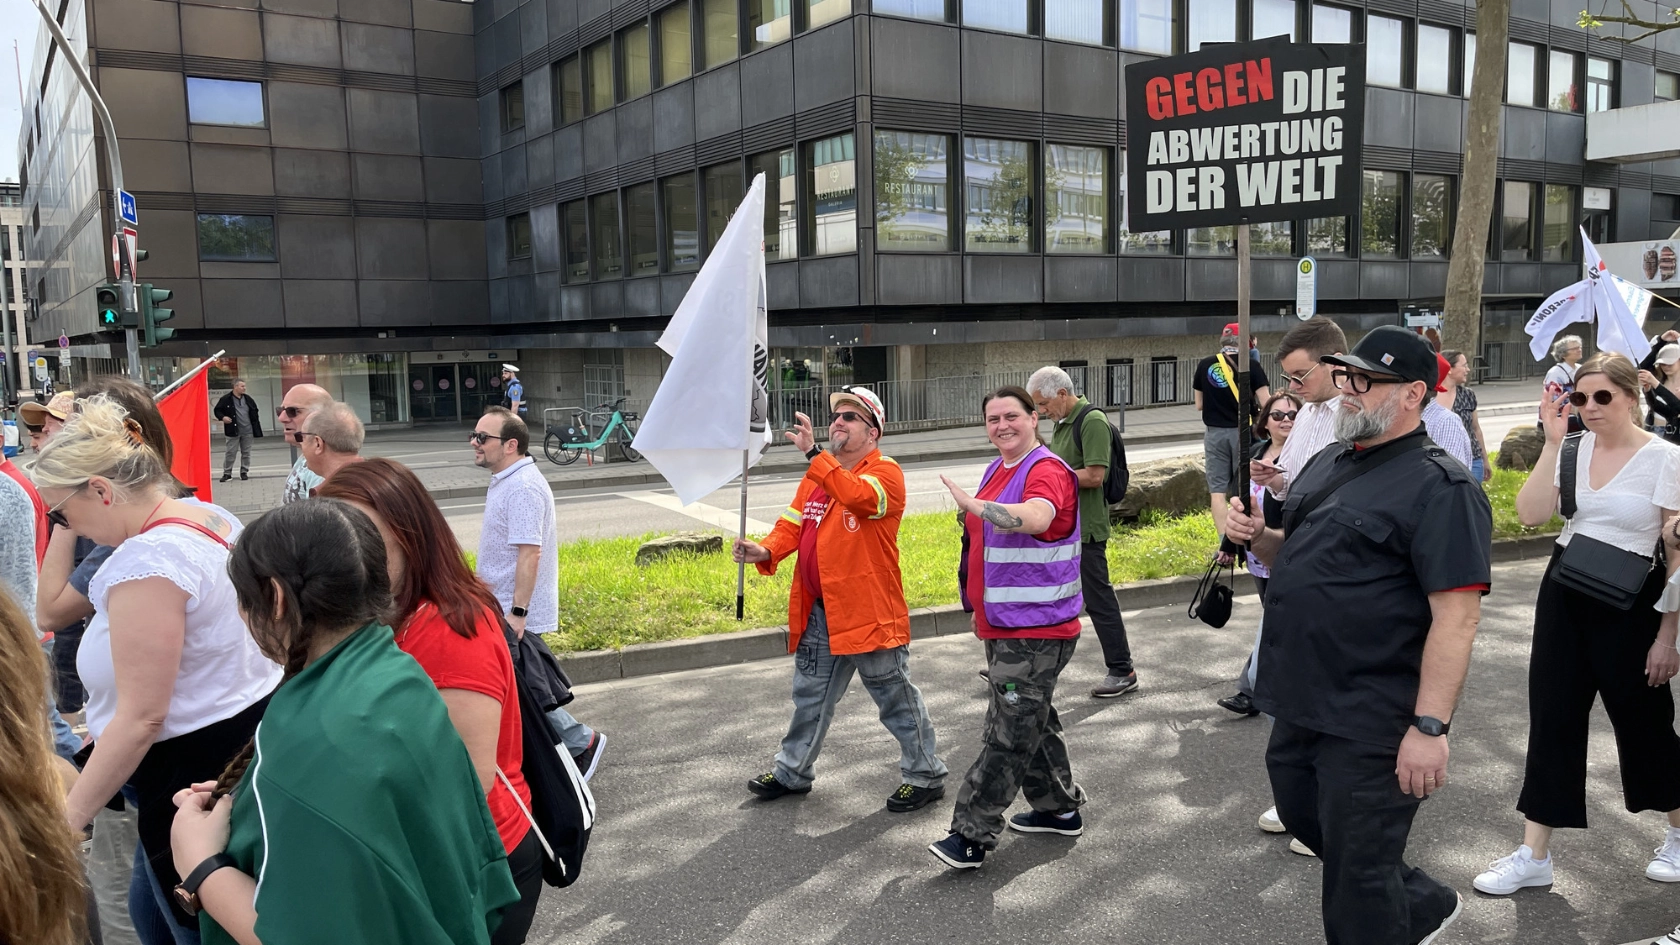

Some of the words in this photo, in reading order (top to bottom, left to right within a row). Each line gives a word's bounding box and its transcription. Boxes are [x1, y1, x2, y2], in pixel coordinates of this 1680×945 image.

[1145, 57, 1274, 121] GEGEN
[1282, 66, 1346, 114] DIE
[1147, 116, 1343, 165] ABWERTUNG
[884, 182, 938, 196] RESTAURANT
[1146, 166, 1225, 214] DER
[1236, 155, 1343, 208] WELT
